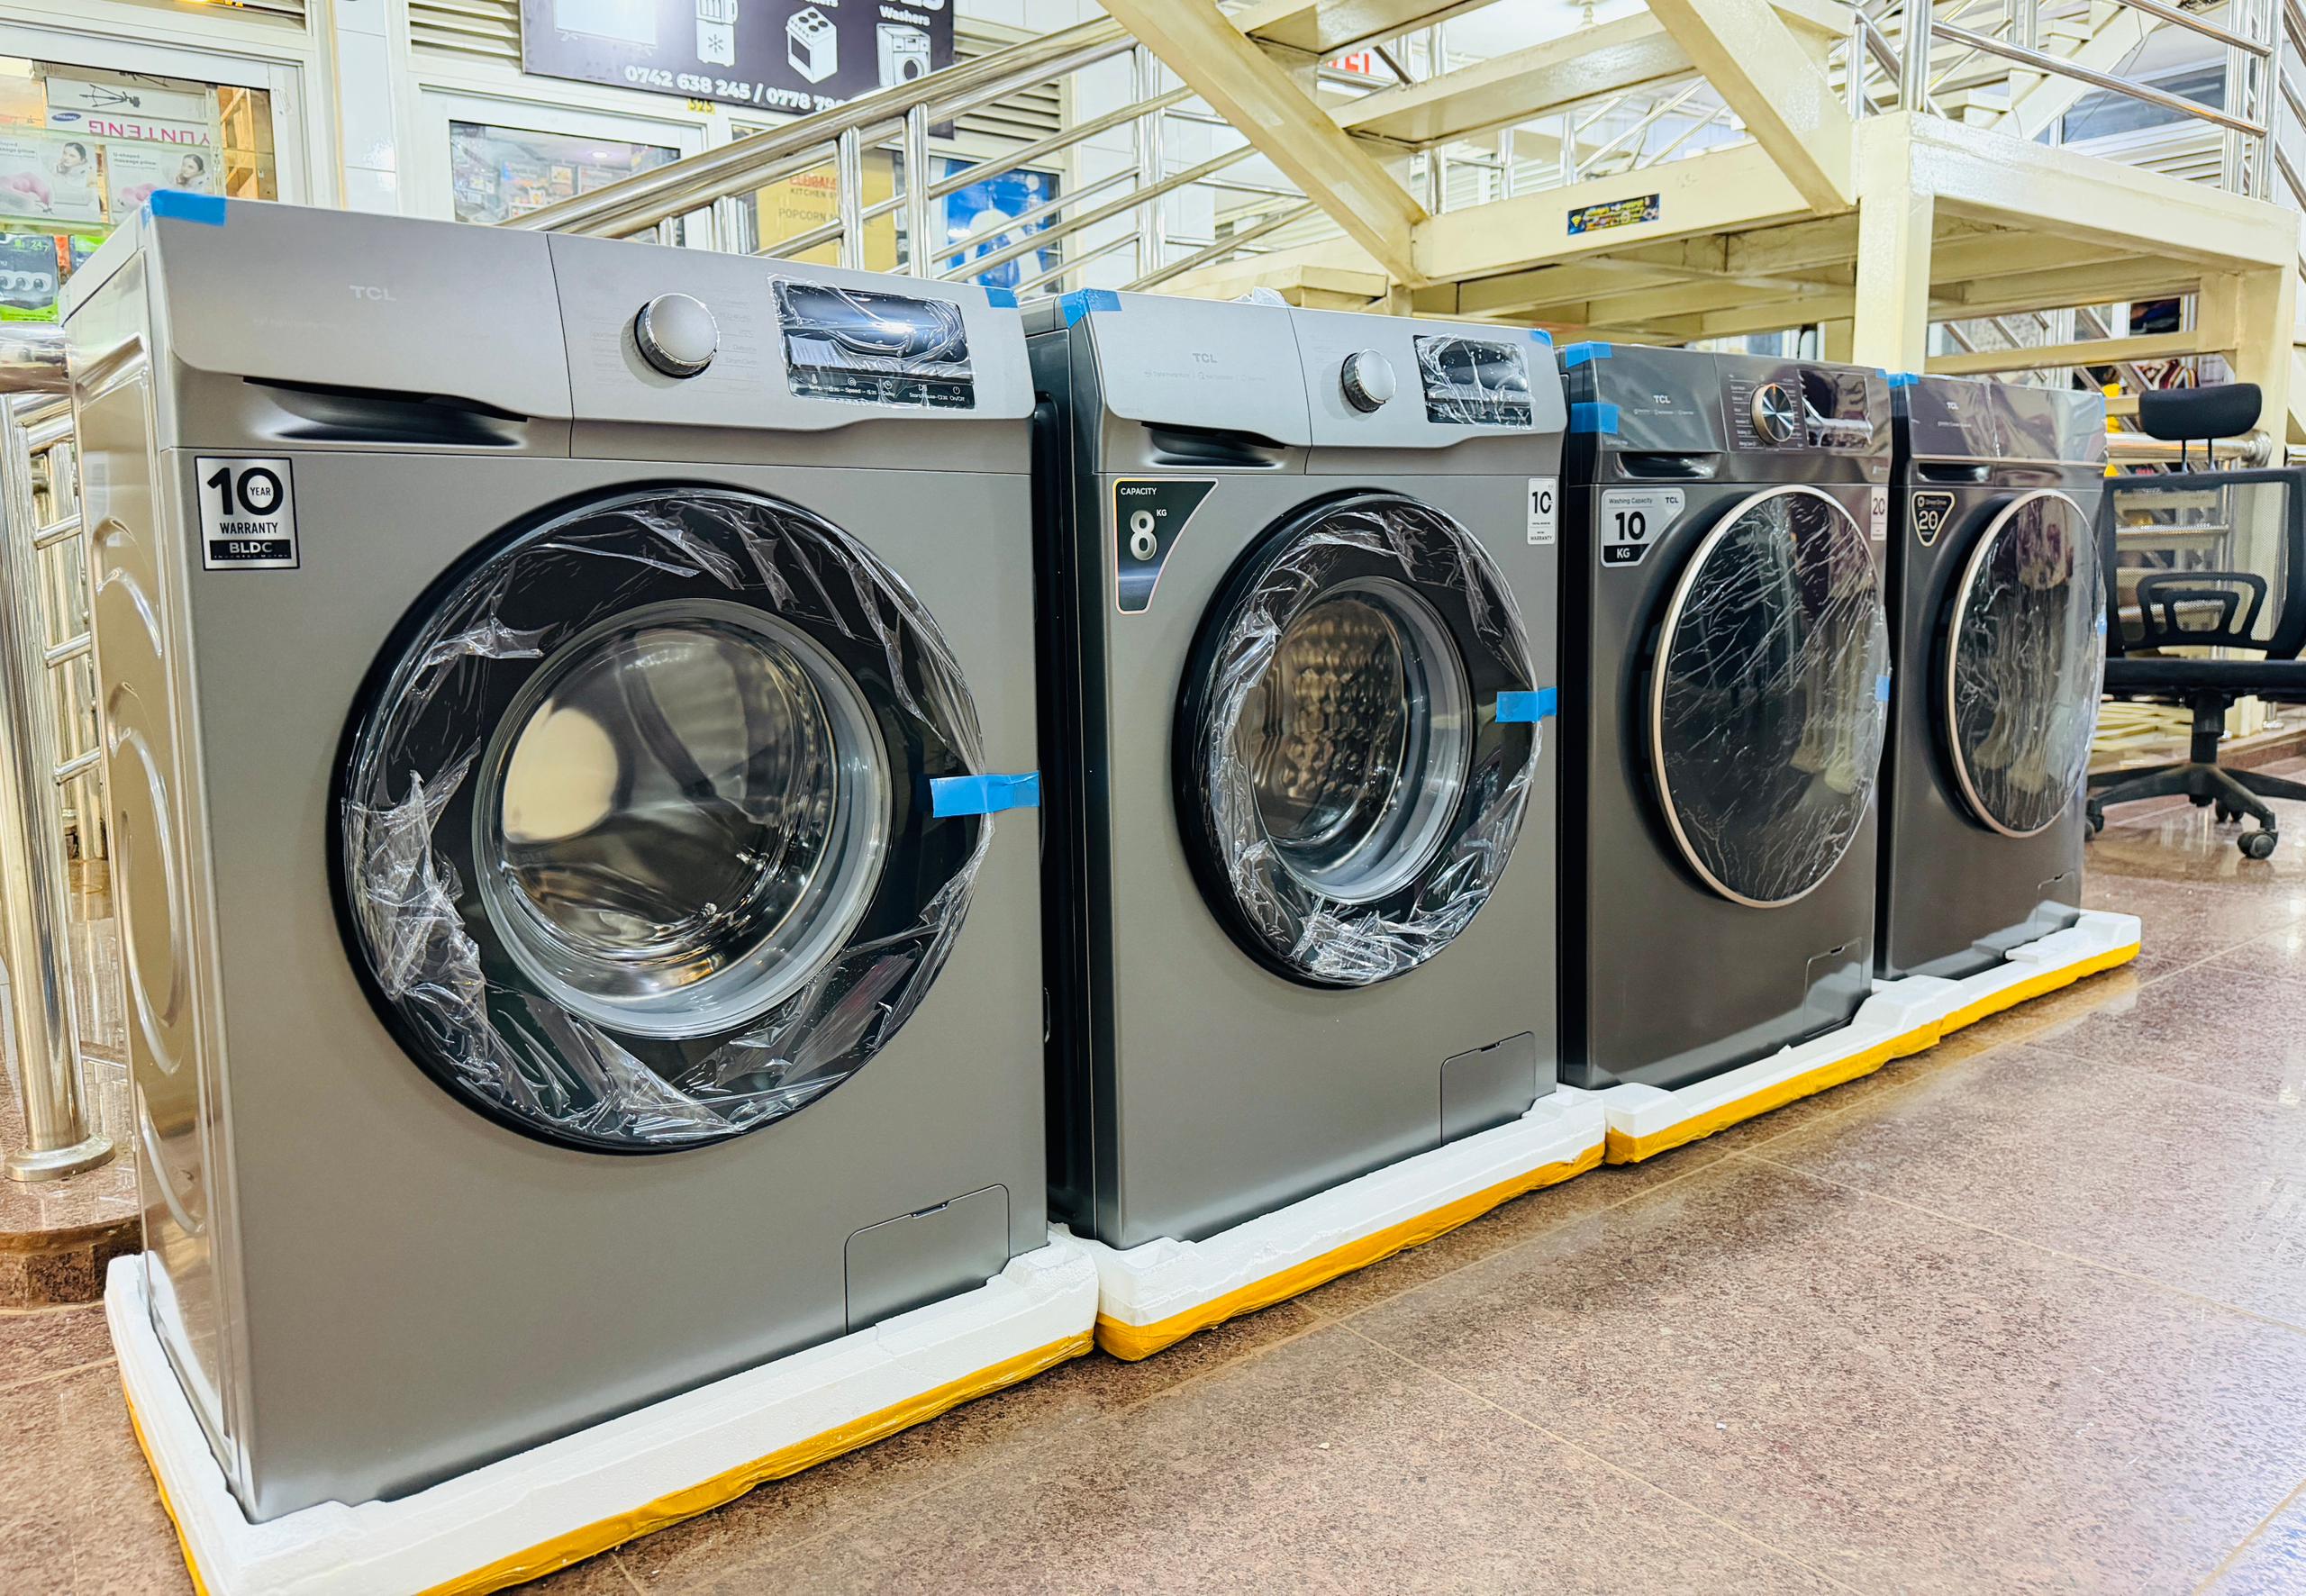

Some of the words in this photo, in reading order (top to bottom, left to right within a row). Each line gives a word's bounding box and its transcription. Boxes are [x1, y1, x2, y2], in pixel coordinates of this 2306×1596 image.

[879, 5, 931, 27] Washers
[624, 65, 674, 87] 0742
[676, 72, 713, 94] 638
[716, 78, 750, 99] 245
[753, 83, 764, 104] /
[766, 87, 811, 110] 0778
[813, 95, 847, 111] 79
[88, 120, 210, 145] YUNTENG
[779, 208, 826, 222] POPCORN
[349, 285, 397, 302] TCL
[1192, 352, 1219, 363] TCL
[1653, 394, 1672, 404] TCL
[207, 467, 284, 516] 10
[250, 486, 271, 496] YEAR
[1121, 487, 1157, 495] CAPACITY
[1156, 509, 1167, 517] KG
[1919, 510, 1938, 530] 20
[220, 522, 278, 534] WARRANTY
[1615, 511, 1647, 540] 10
[1130, 510, 1158, 561] 8
[229, 542, 273, 554] BLDC
[1616, 548, 1630, 558] KG
